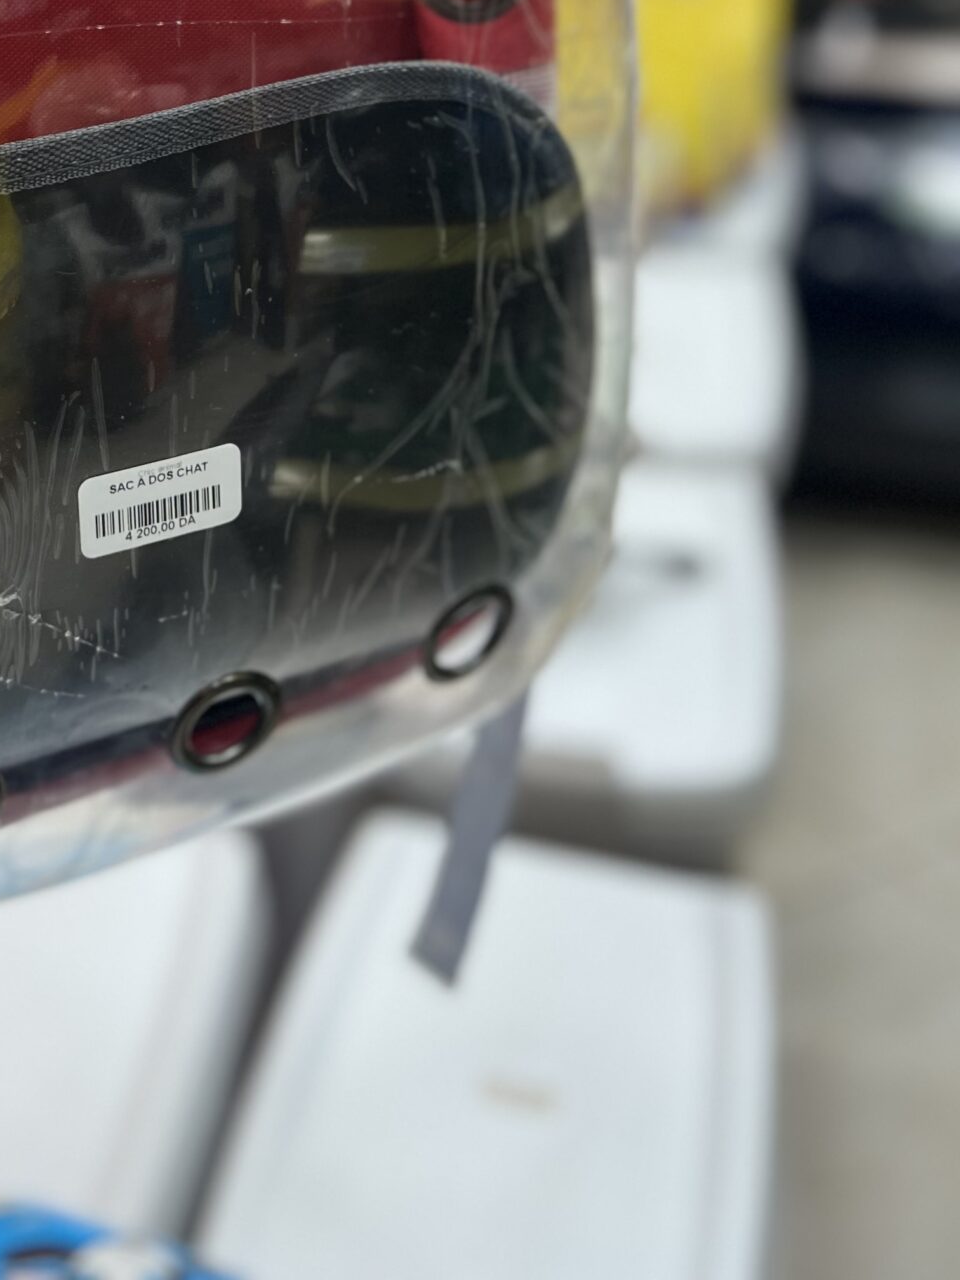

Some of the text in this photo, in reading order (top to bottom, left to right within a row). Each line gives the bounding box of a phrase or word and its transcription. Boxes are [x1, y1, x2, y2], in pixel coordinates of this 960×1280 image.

[109, 480, 134, 495] SAC
[148, 470, 174, 485] DOS
[176, 461, 209, 478] CHAT
[125, 531, 133, 541] 4
[179, 515, 196, 528] DA
